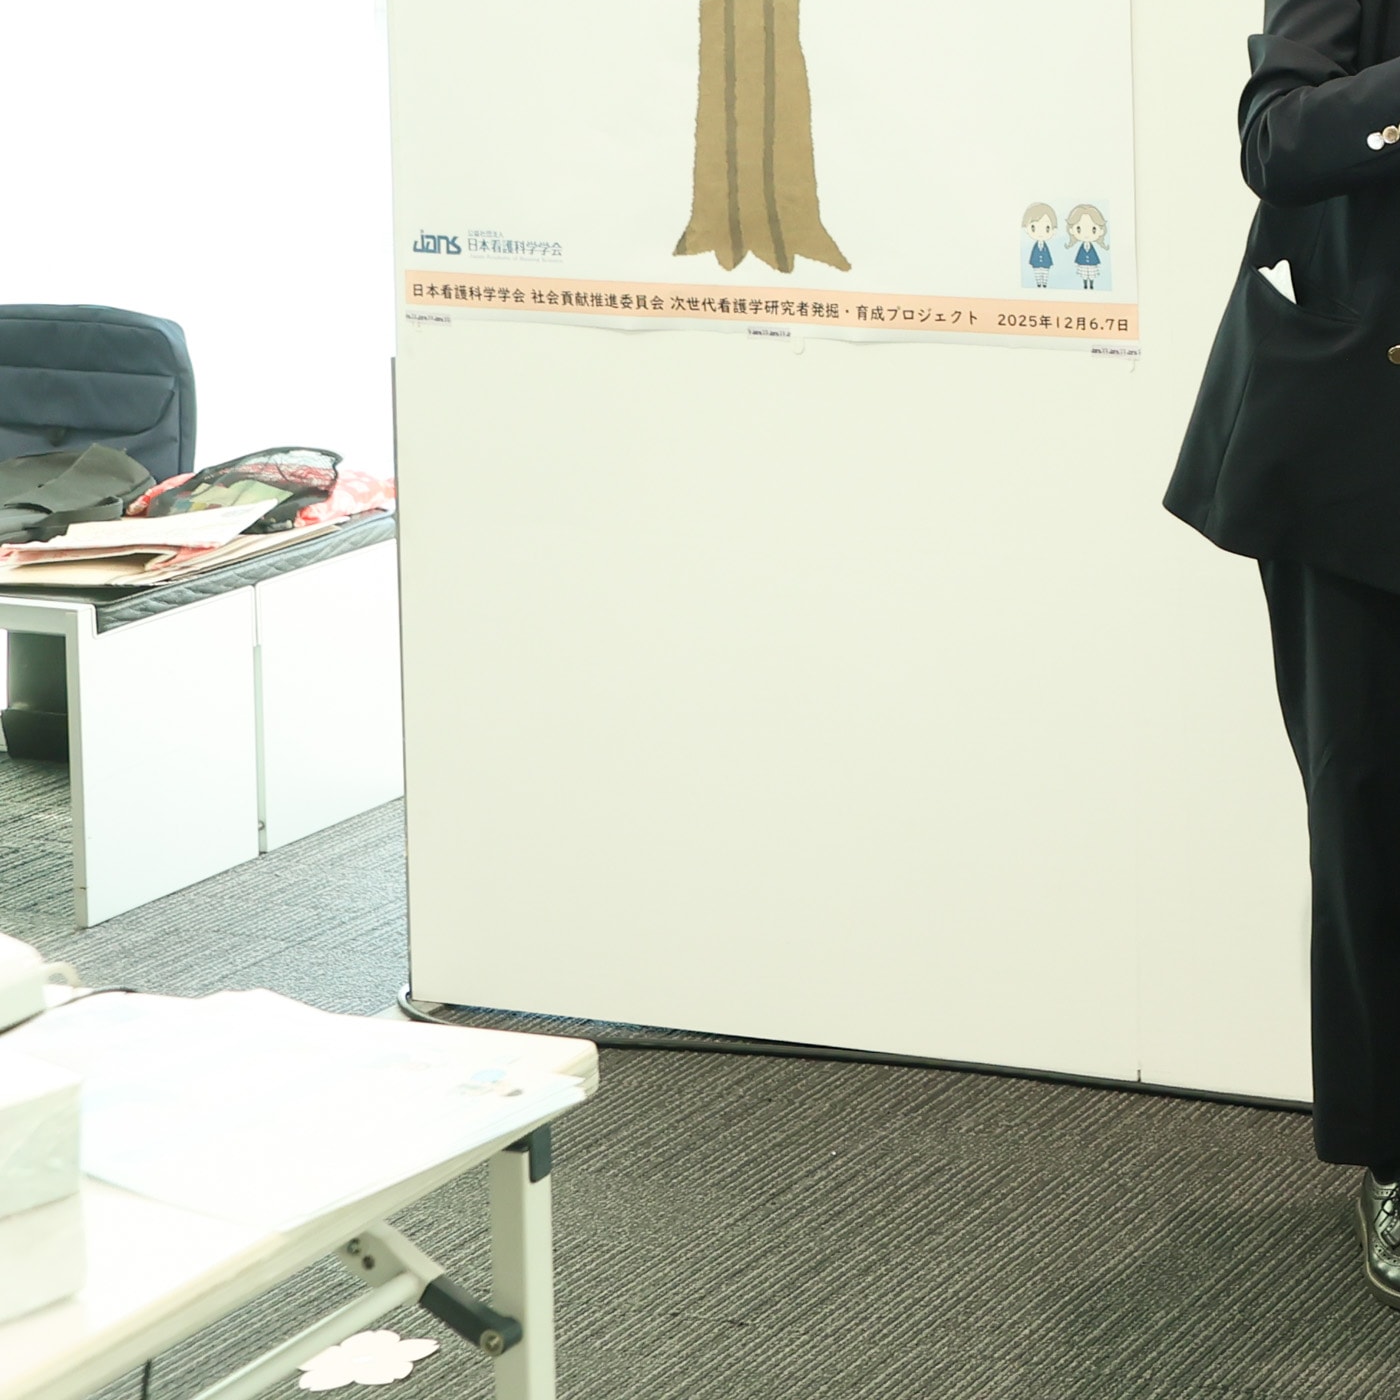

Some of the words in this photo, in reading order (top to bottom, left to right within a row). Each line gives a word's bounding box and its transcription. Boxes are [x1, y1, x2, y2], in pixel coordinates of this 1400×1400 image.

[467, 229, 504, 239] 公益社団法人
[467, 238, 563, 257] 日本看護科学学会
[412, 283, 526, 304] 日本看護科学学会
[531, 287, 664, 311] 社会貢献推進委員会
[670, 295, 978, 326] 次世代看護学研究者発掘・育成プロジェクト
[998, 311, 1130, 333] 2025年12月6.7日
